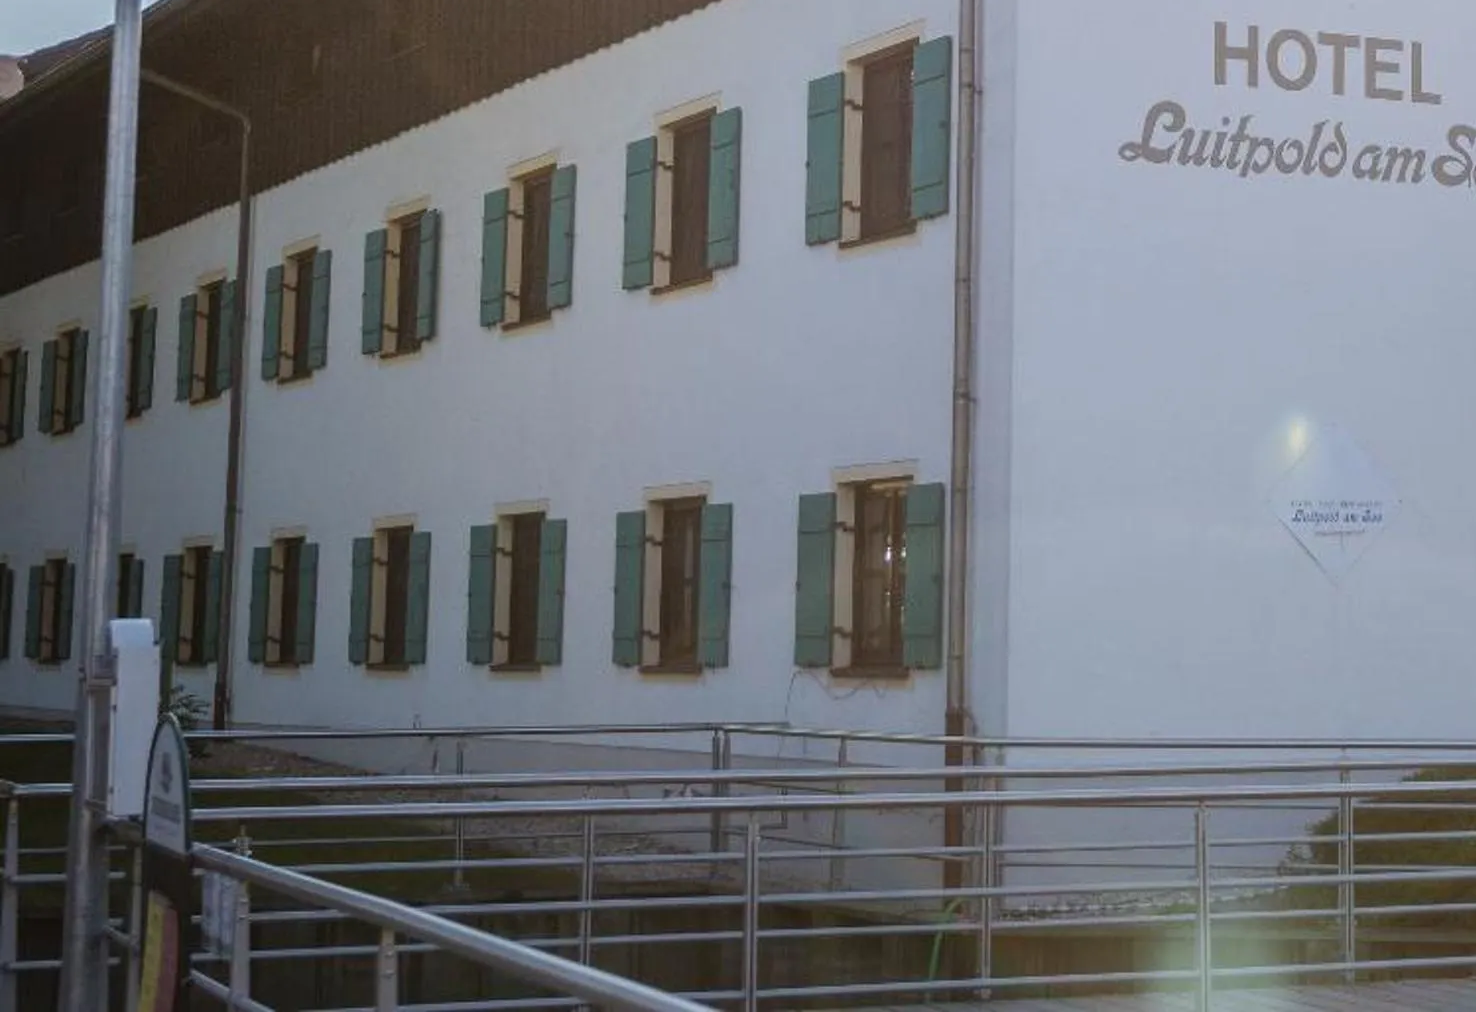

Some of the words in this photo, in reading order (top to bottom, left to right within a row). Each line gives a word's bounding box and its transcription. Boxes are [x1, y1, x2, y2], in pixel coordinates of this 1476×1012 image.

[1213, 21, 1442, 105] HOTEL
[1117, 100, 1348, 178] Luitpold
[1352, 143, 1427, 184] am
